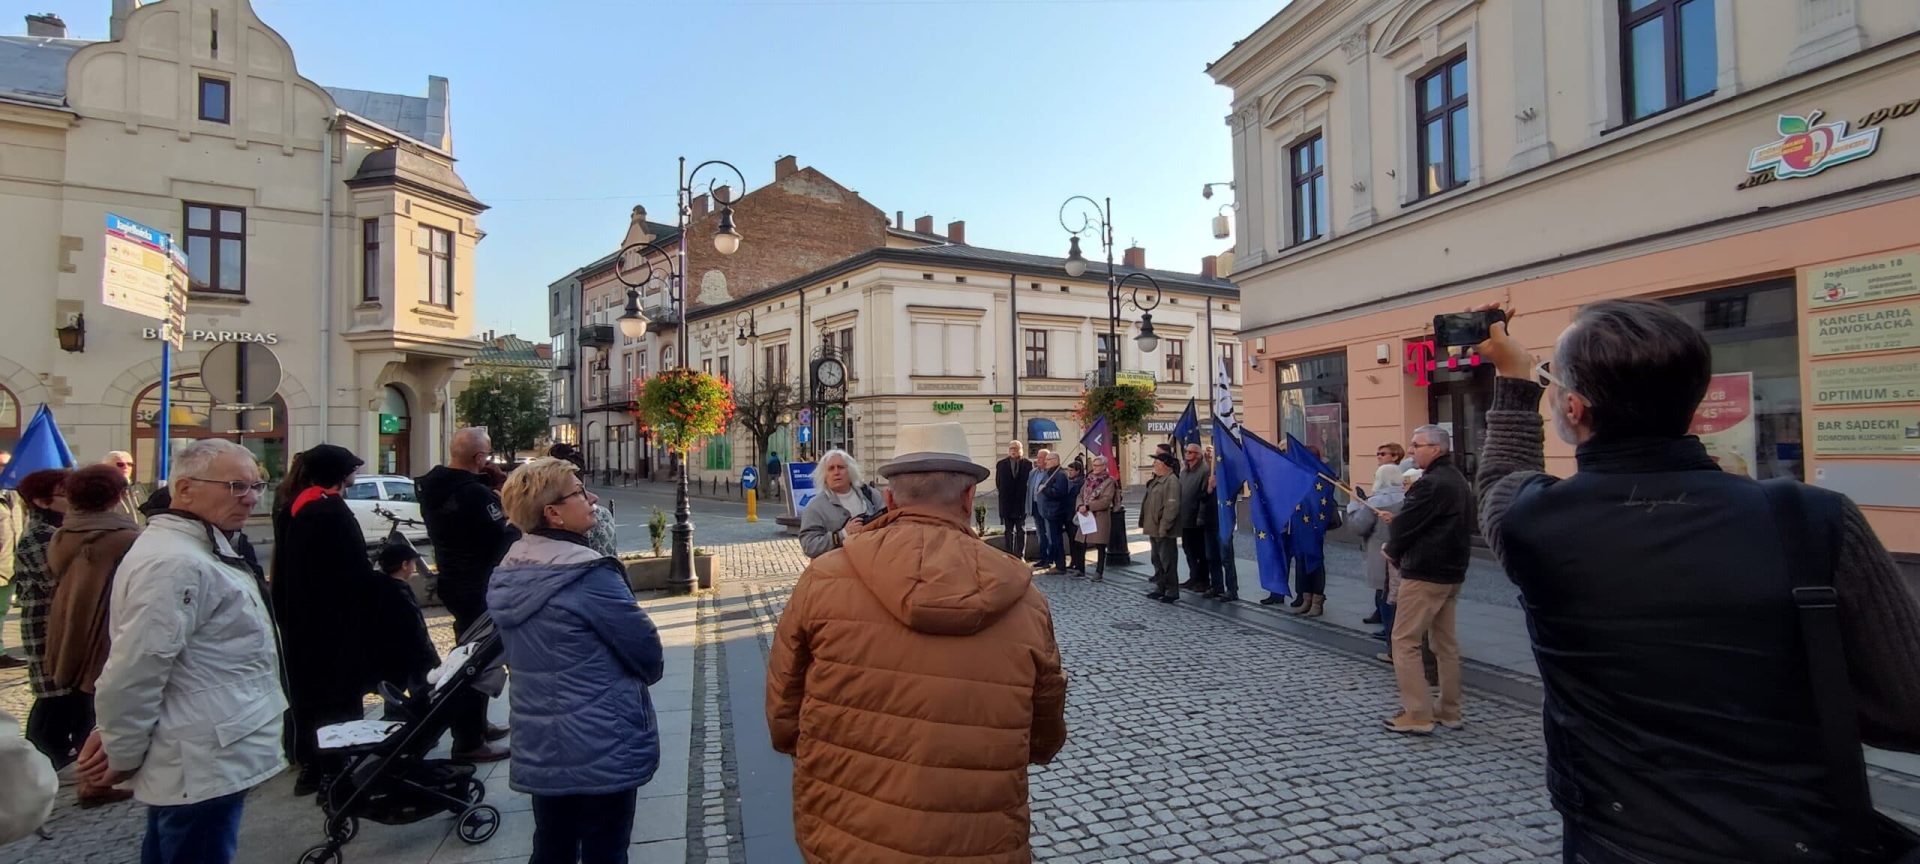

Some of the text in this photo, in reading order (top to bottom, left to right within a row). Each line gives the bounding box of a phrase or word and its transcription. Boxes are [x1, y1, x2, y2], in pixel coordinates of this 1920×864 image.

[1819, 308, 1911, 326] KANCELARIA
[1819, 318, 1914, 337] ADWOKACKA
[193, 330, 278, 344] PARIBAS
[1819, 388, 1887, 401] OPTIMUM
[1817, 420, 1900, 432] BAR SĄDECKI
